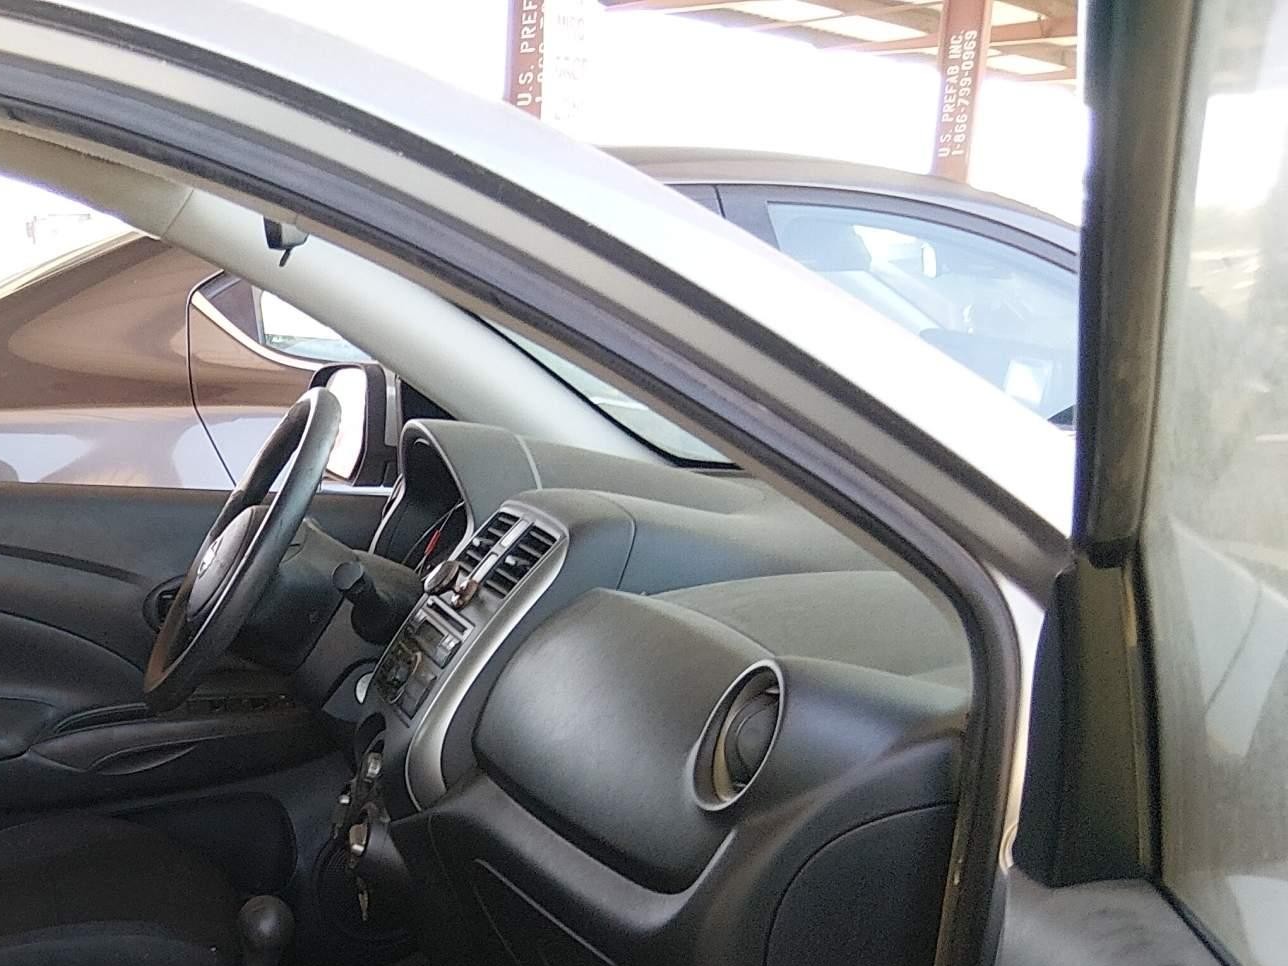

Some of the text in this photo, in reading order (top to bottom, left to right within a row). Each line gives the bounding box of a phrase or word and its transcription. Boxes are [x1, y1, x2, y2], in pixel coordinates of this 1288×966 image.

[516, 65, 535, 106] U.S.
[938, 30, 964, 157] U.S. PREFAB INC.
[952, 30, 978, 155] 1-866-799-0969
